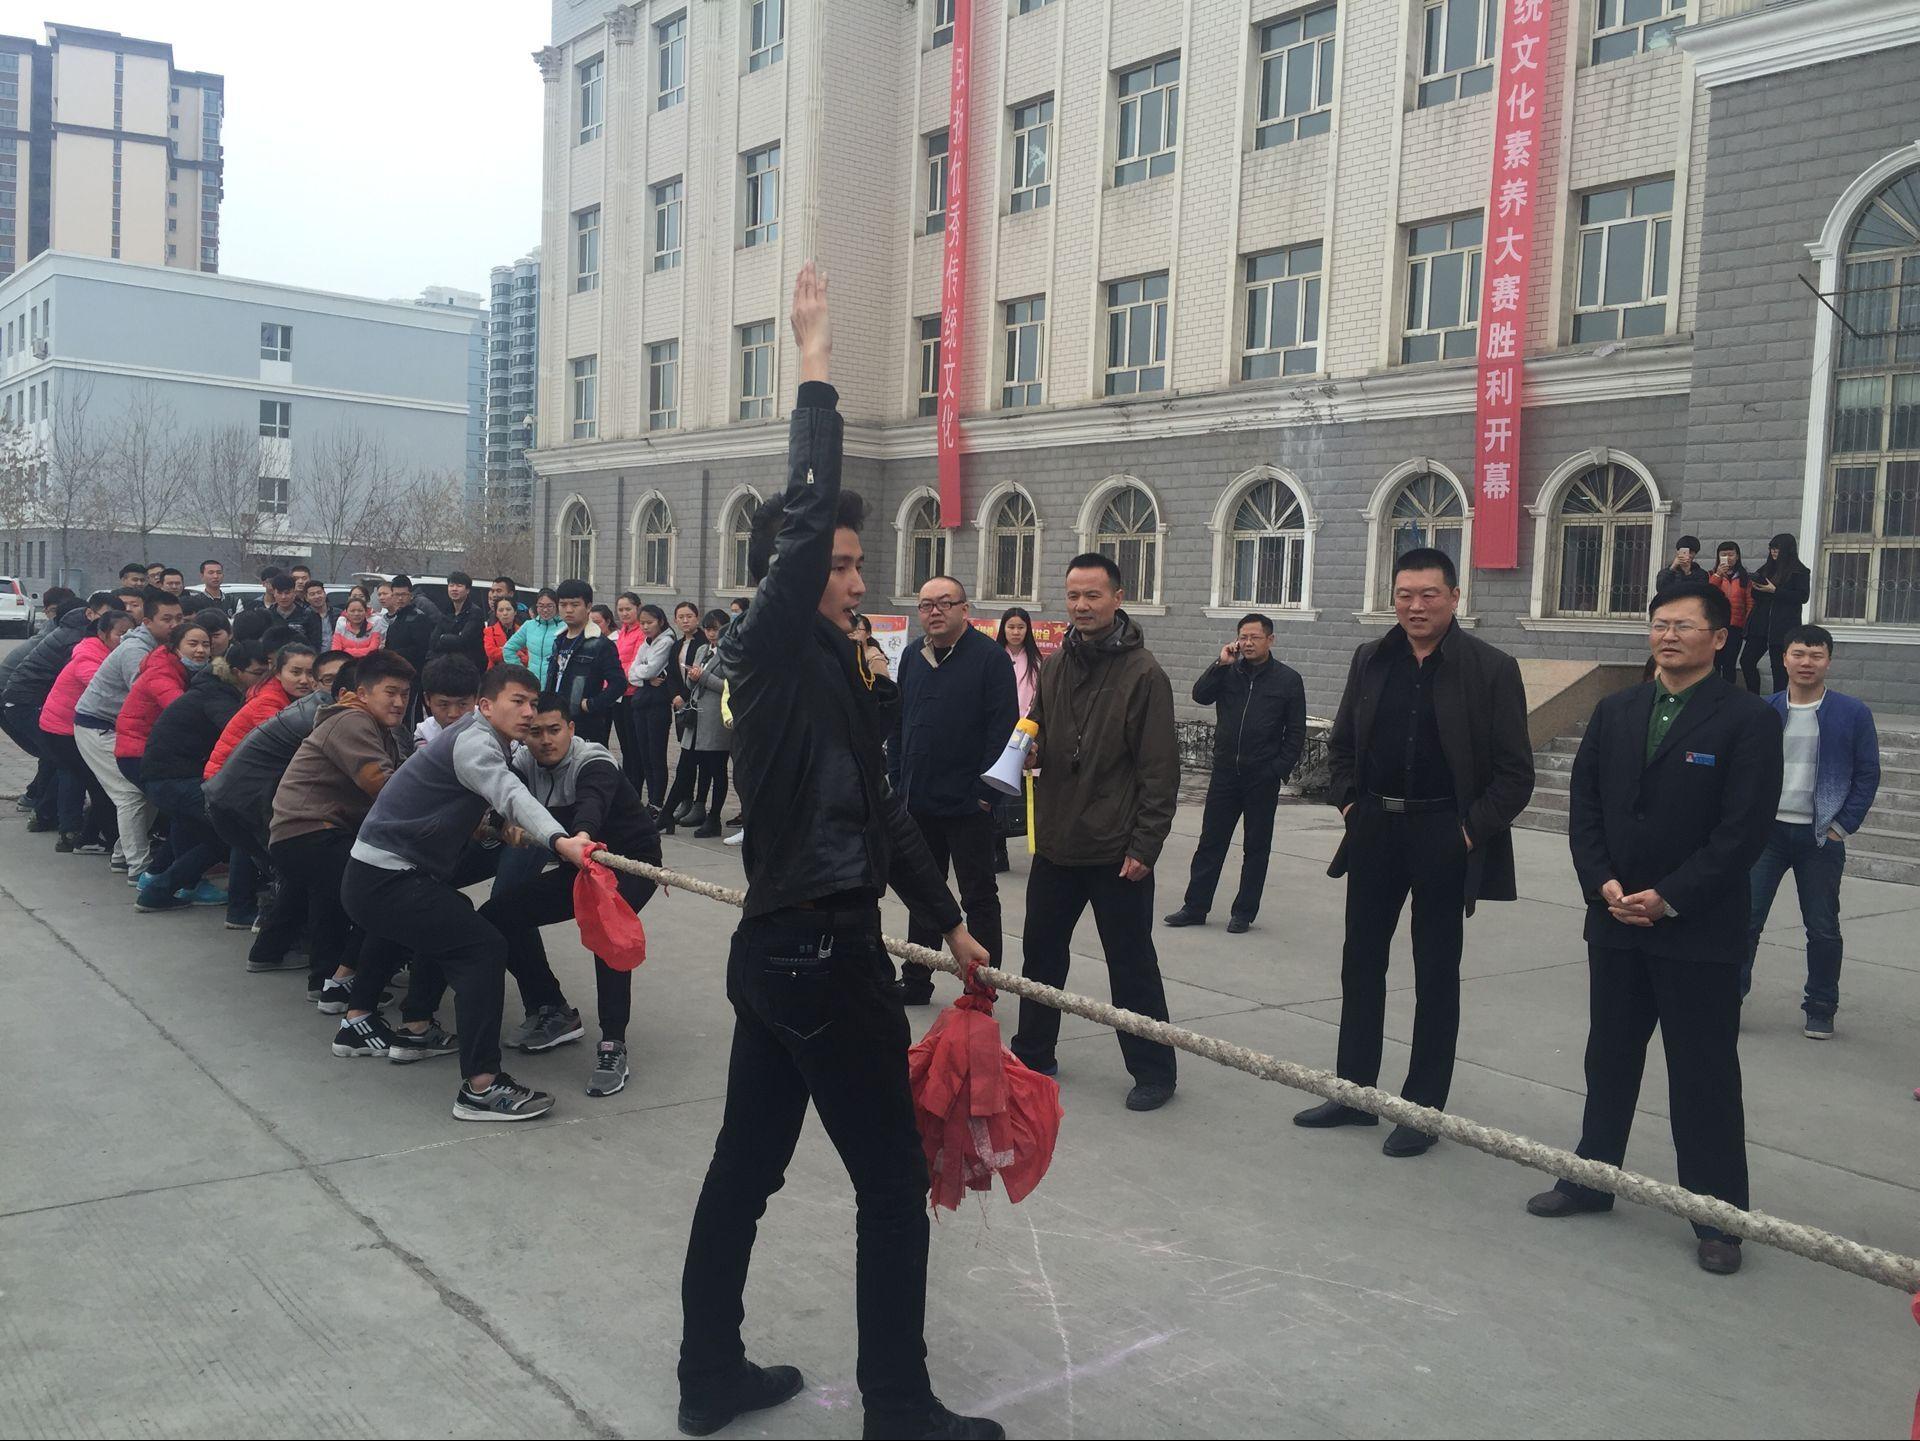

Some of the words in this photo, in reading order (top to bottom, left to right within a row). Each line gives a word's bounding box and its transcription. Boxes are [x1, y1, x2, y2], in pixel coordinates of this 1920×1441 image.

[942, 46, 965, 449] 弘扬优秀传统文化
[1483, 0, 1543, 500] 统文化素养大赛胜利开幕
